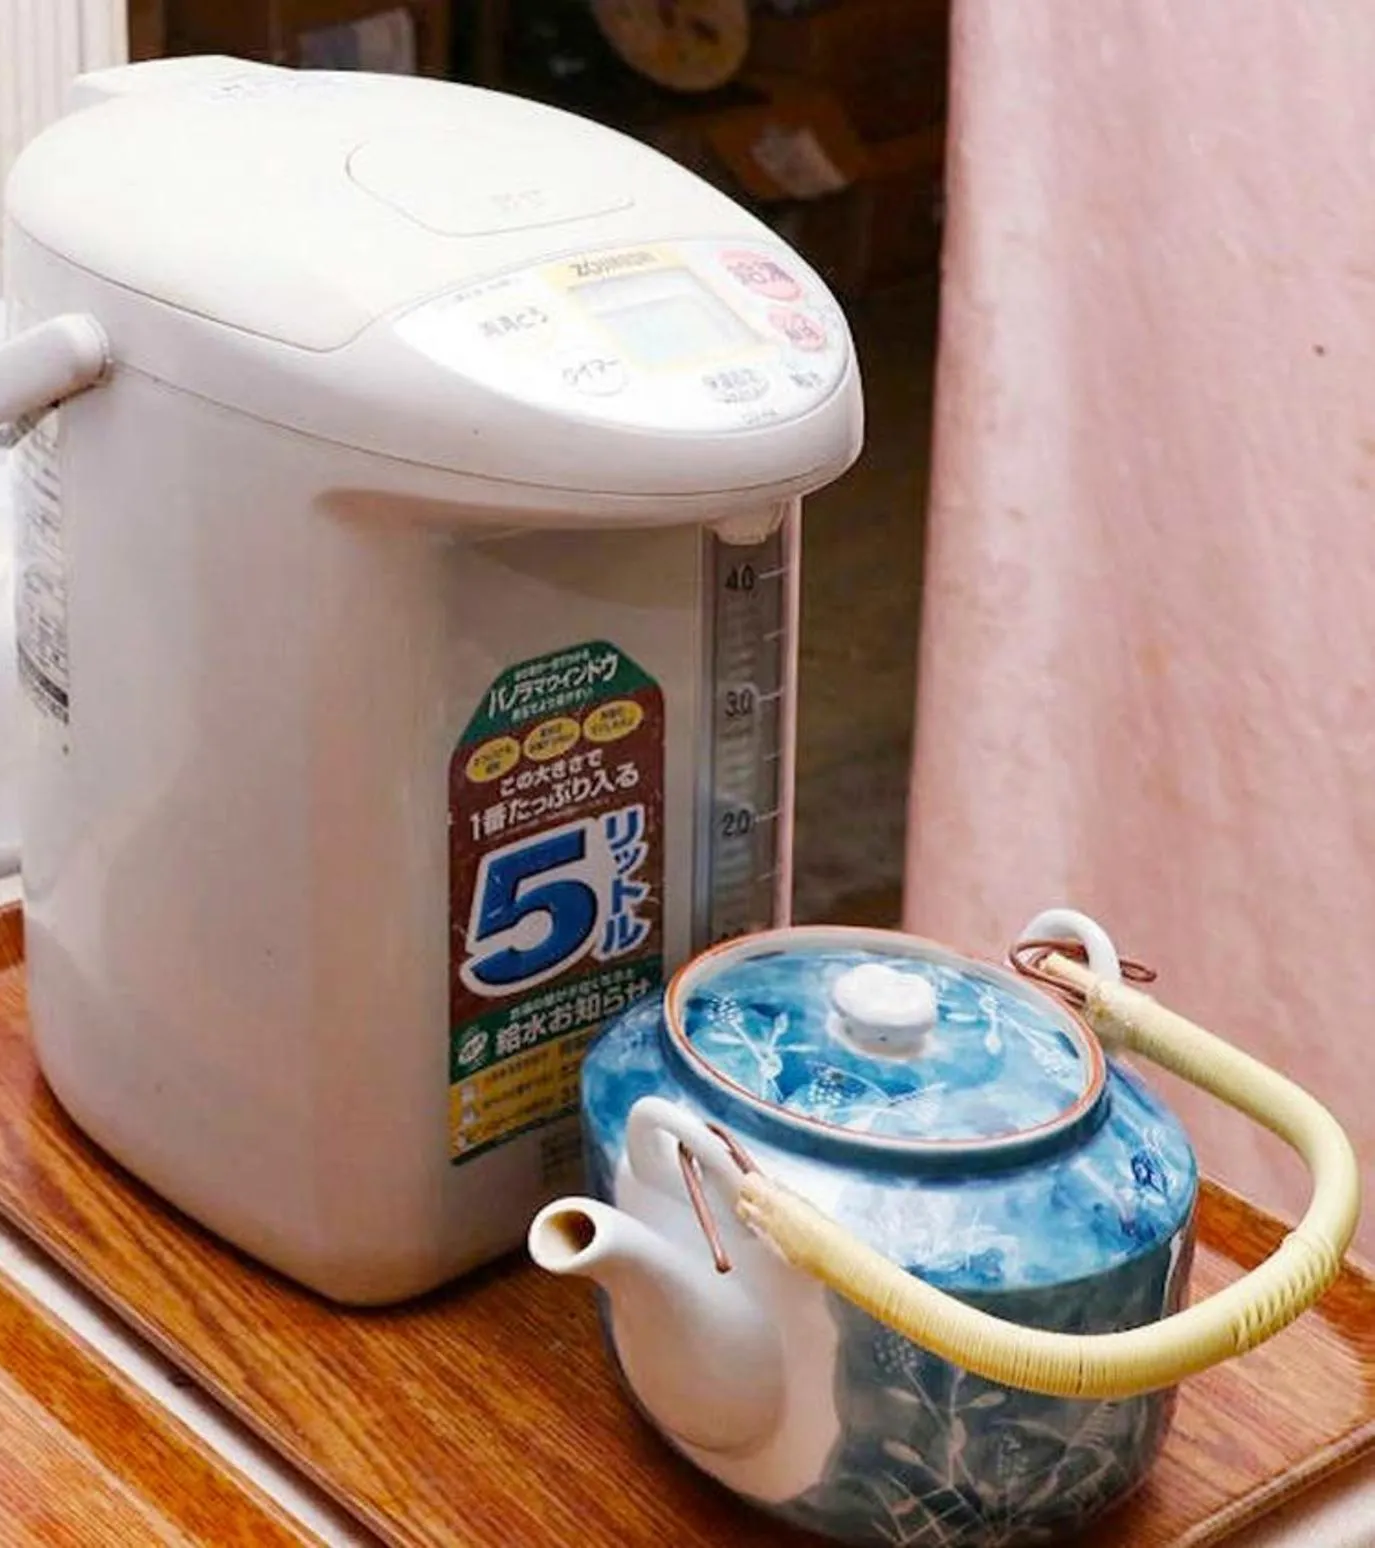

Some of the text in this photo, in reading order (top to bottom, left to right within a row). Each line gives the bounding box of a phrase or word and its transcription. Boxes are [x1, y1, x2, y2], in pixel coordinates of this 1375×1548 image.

[725, 690, 753, 718] 3.0
[500, 748, 603, 798] この大きさで
[721, 808, 751, 837] 2.0
[460, 817, 599, 997] 5
[594, 803, 651, 962] リットル
